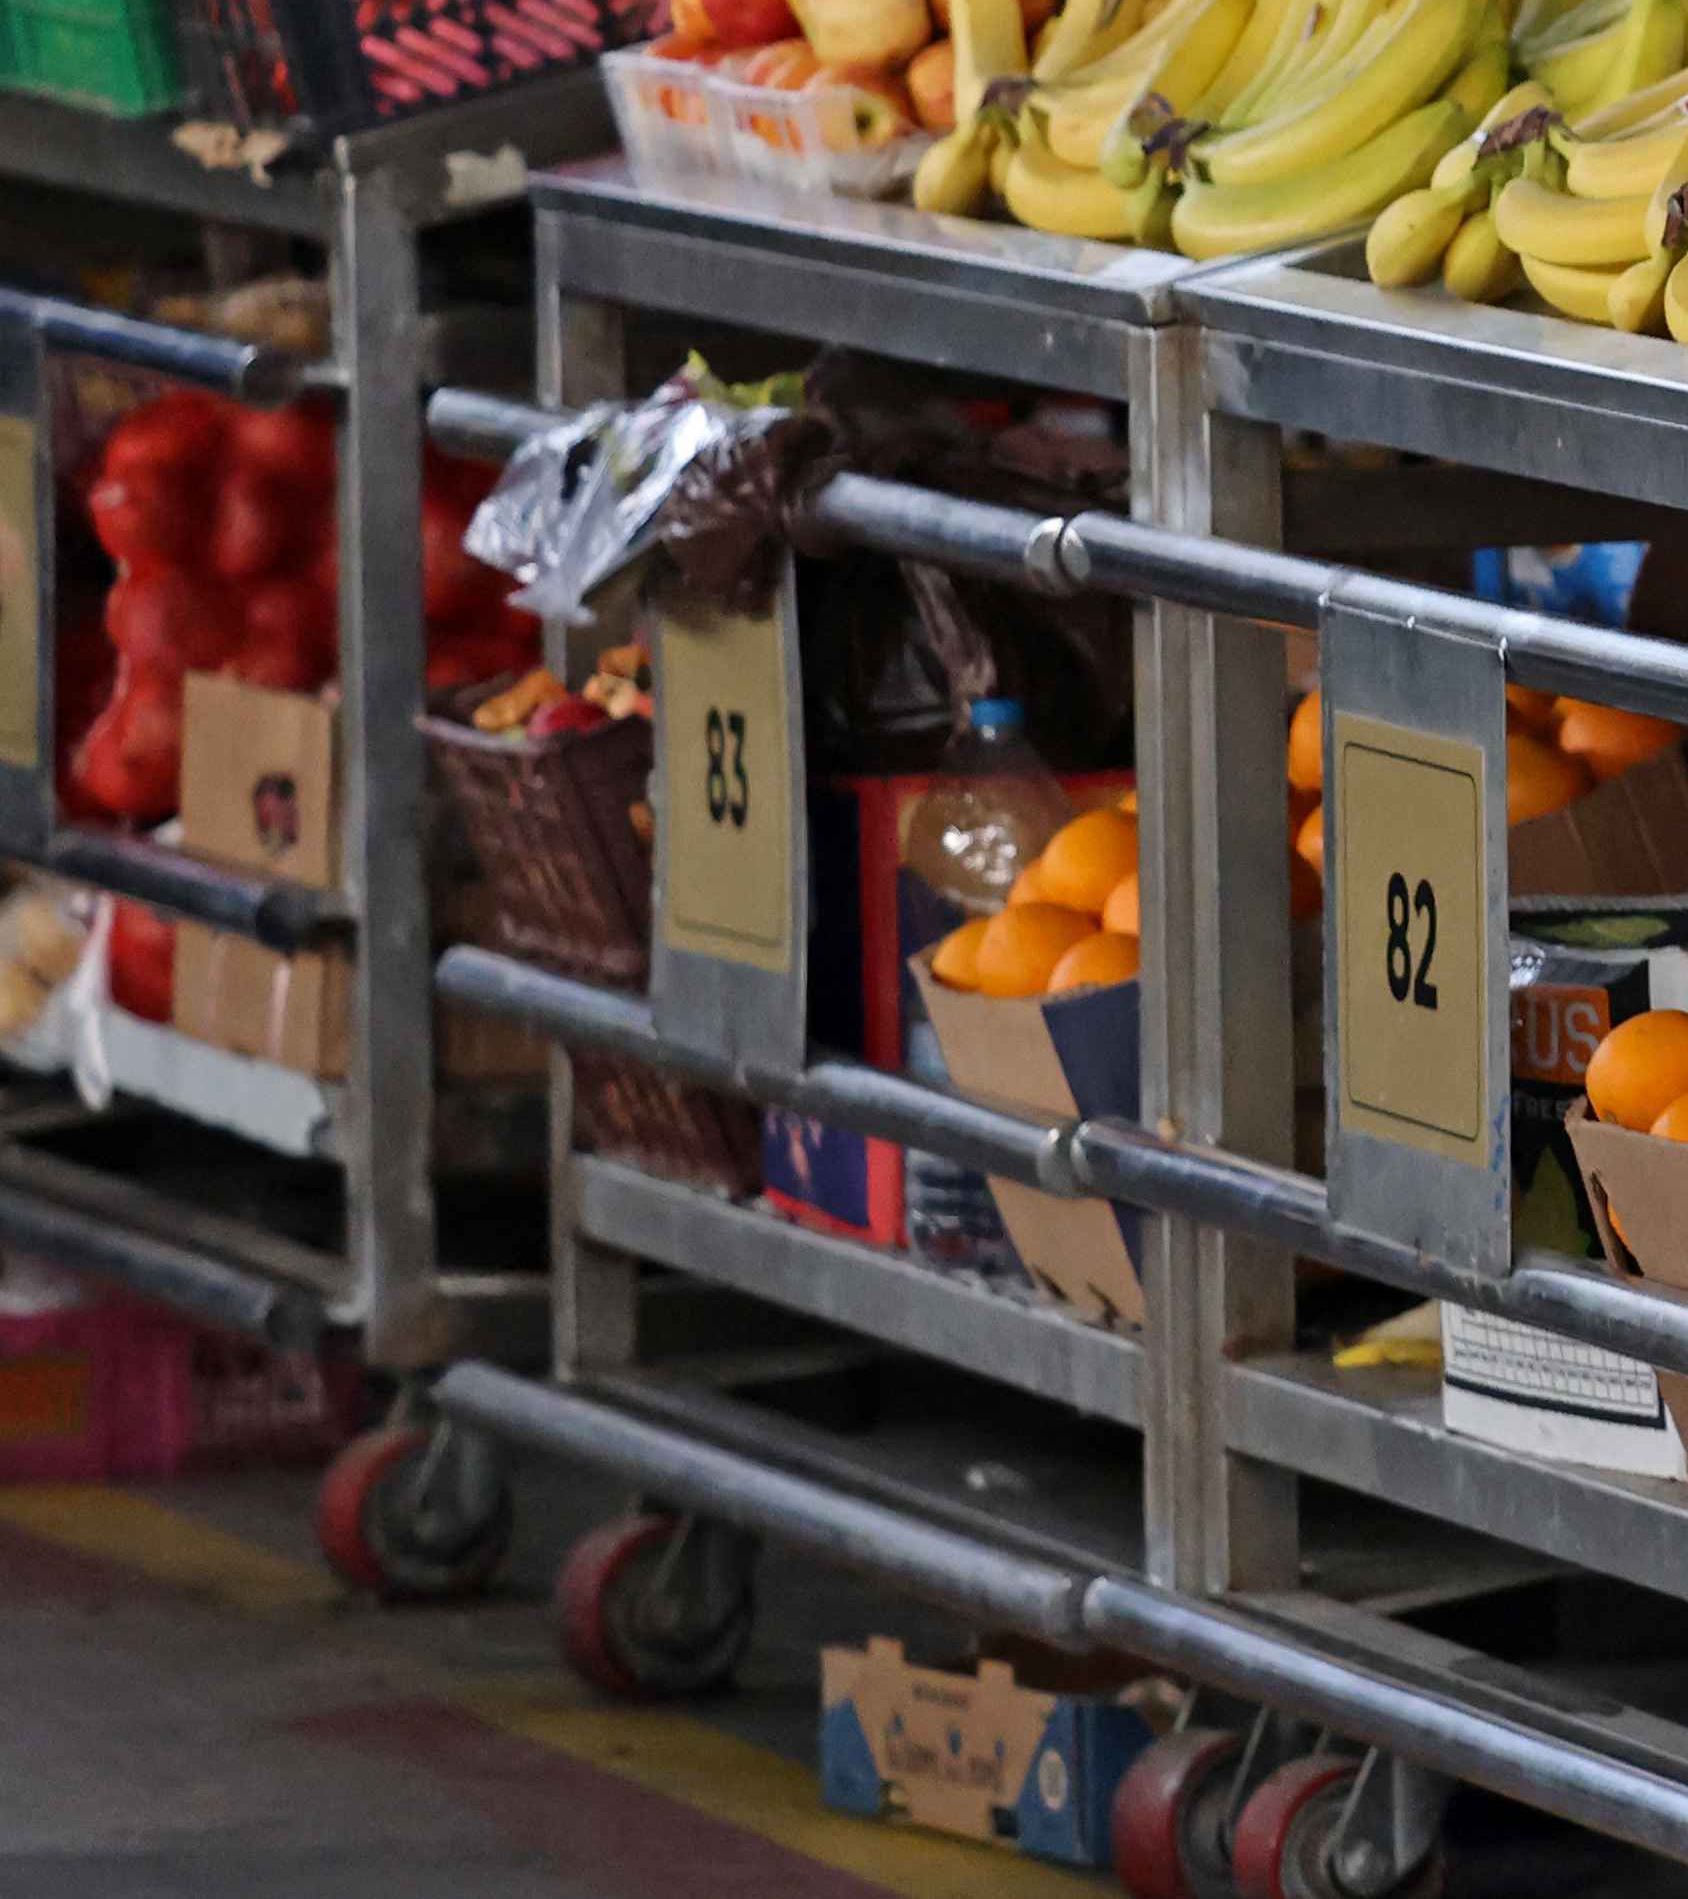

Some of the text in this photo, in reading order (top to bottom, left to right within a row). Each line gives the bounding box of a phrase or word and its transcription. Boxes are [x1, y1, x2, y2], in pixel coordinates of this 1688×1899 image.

[706, 706, 749, 829] 83
[1385, 871, 1439, 1010] 82
[1514, 998, 1601, 1074] US
